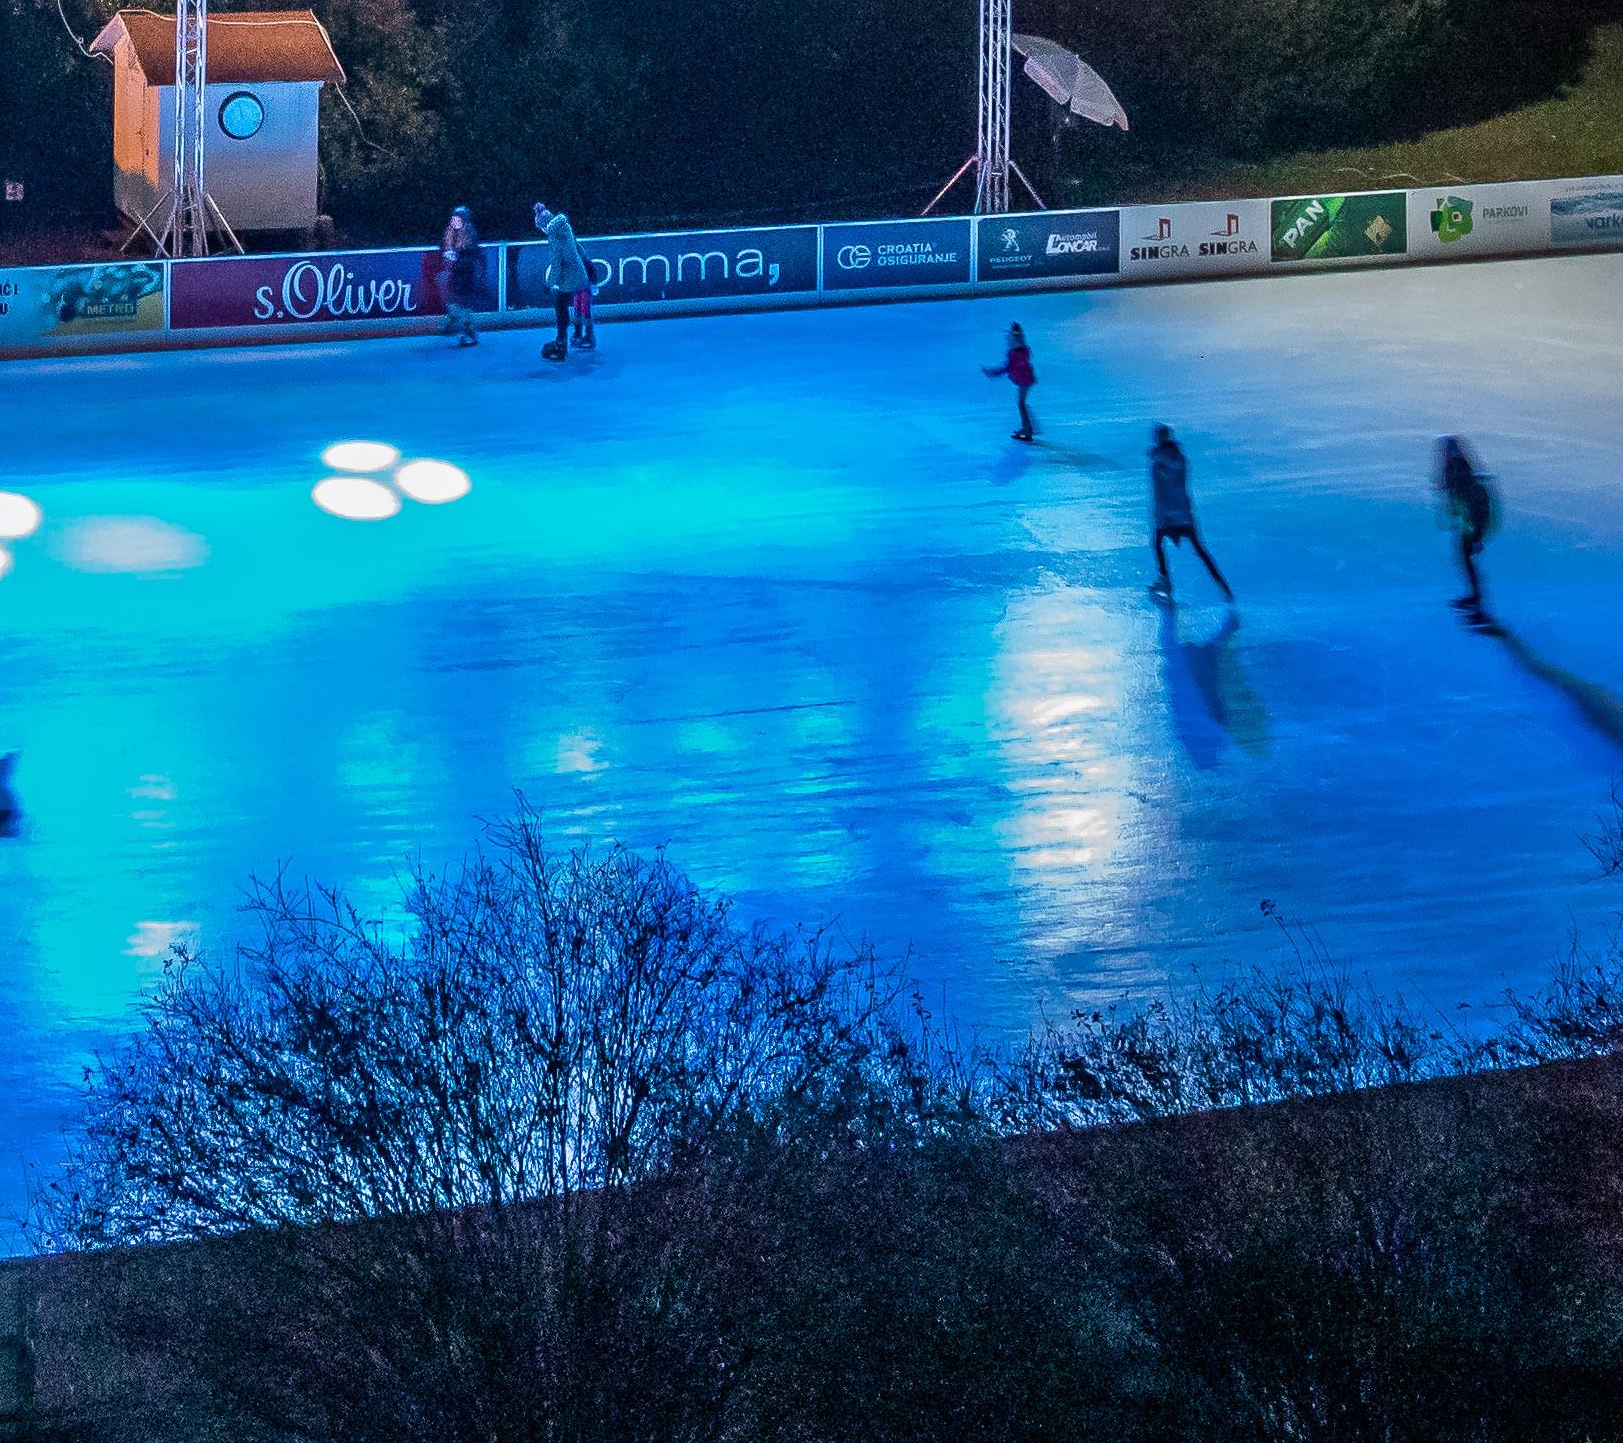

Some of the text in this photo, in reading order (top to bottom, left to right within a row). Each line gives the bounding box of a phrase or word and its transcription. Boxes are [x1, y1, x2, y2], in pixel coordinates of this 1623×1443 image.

[1482, 207, 1529, 219] PARKOVI
[1282, 199, 1326, 249] PAN
[877, 242, 933, 255] CROATIA
[1130, 244, 1191, 261] SINGRA
[1198, 240, 1258, 256] SINGRA
[877, 253, 957, 266] OSIGURANJE
[254, 260, 417, 319] s.Oliver
